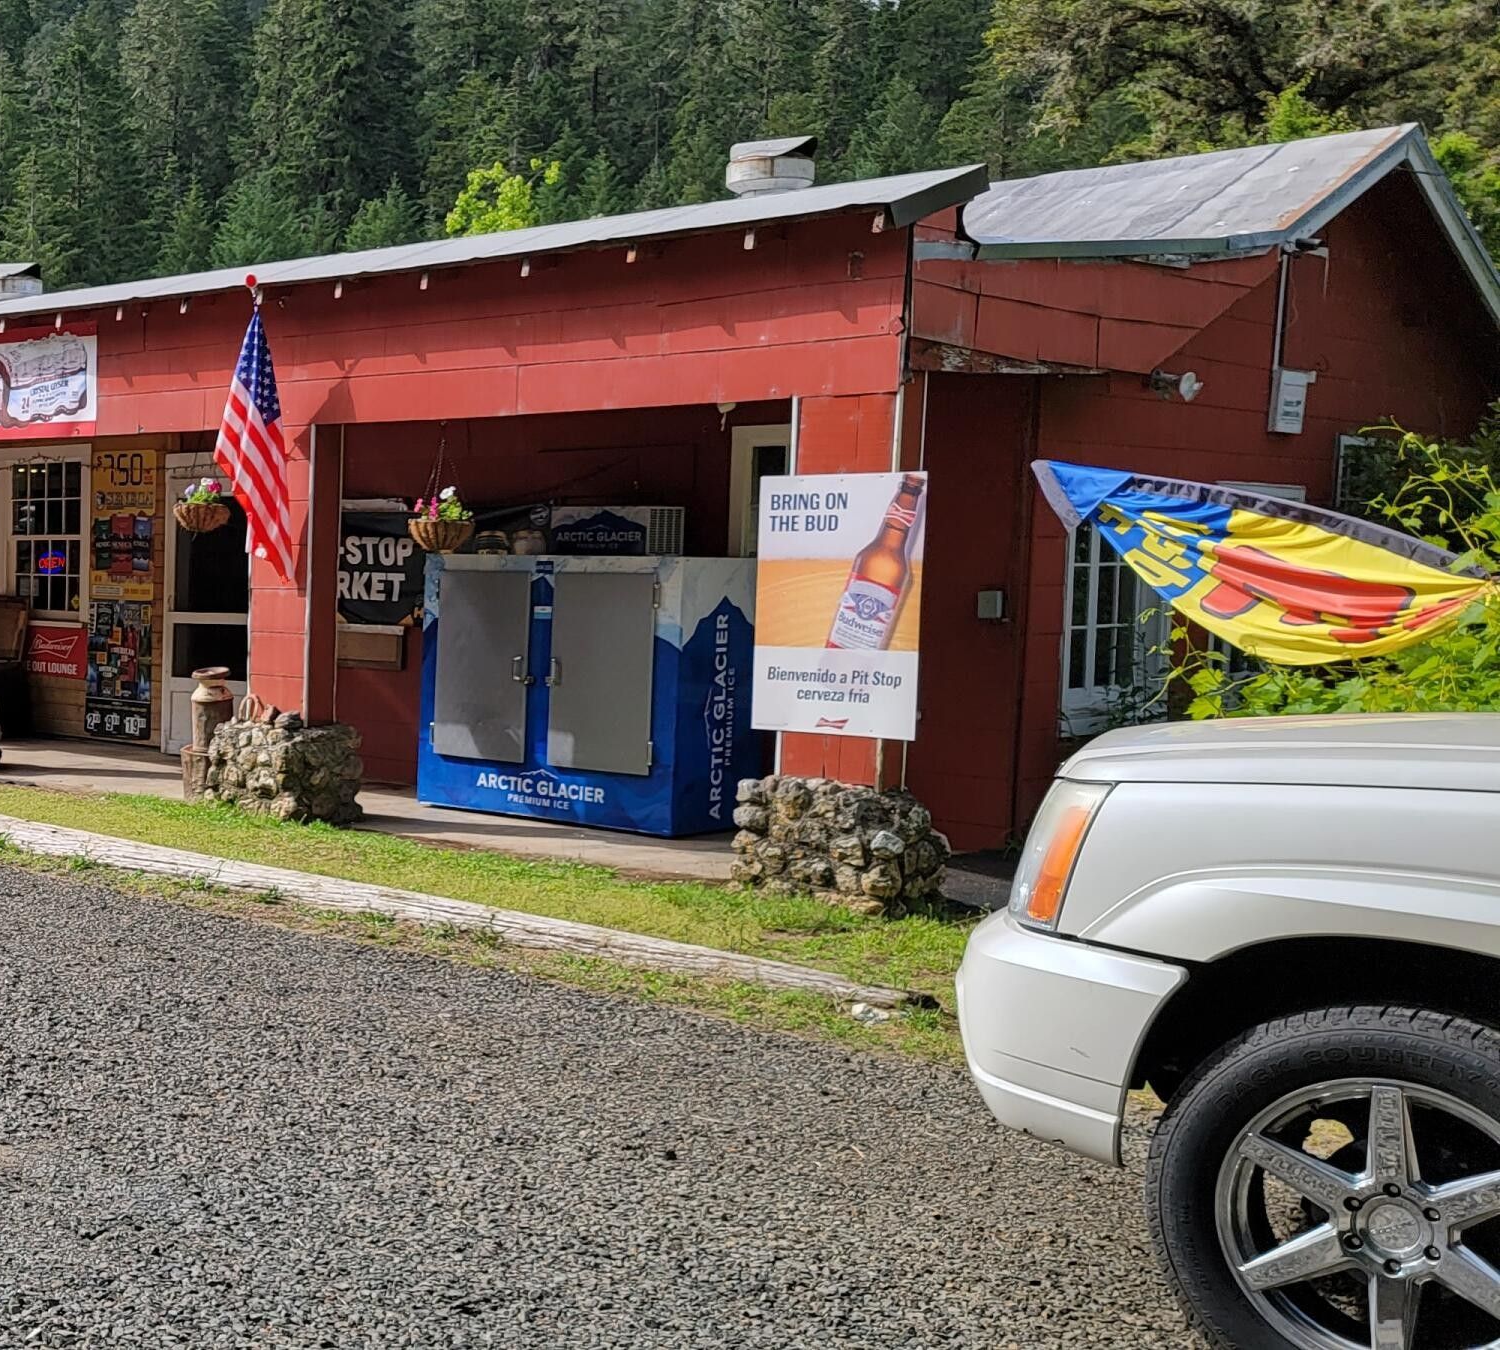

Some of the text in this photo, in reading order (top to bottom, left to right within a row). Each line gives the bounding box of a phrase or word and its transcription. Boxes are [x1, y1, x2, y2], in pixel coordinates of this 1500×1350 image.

[771, 492, 848, 511] BRING ON
[769, 514, 839, 532] THE BUD
[556, 531, 642, 542] ARCTIC GLACIER
[38, 556, 66, 569] OPEN
[838, 610, 884, 638] Budweiser
[31, 661, 47, 672] OUT
[47, 662, 78, 675] LOUNGE
[767, 666, 902, 689] Bienvenido a Pit Stop
[796, 688, 870, 704] cerveza fria
[709, 613, 729, 820] ARCTIC GLACIER
[724, 667, 736, 766] PREMIUM ICE
[475, 772, 605, 804] ARCTIC GLACIER
[506, 793, 570, 811] PREMIUM ICE
